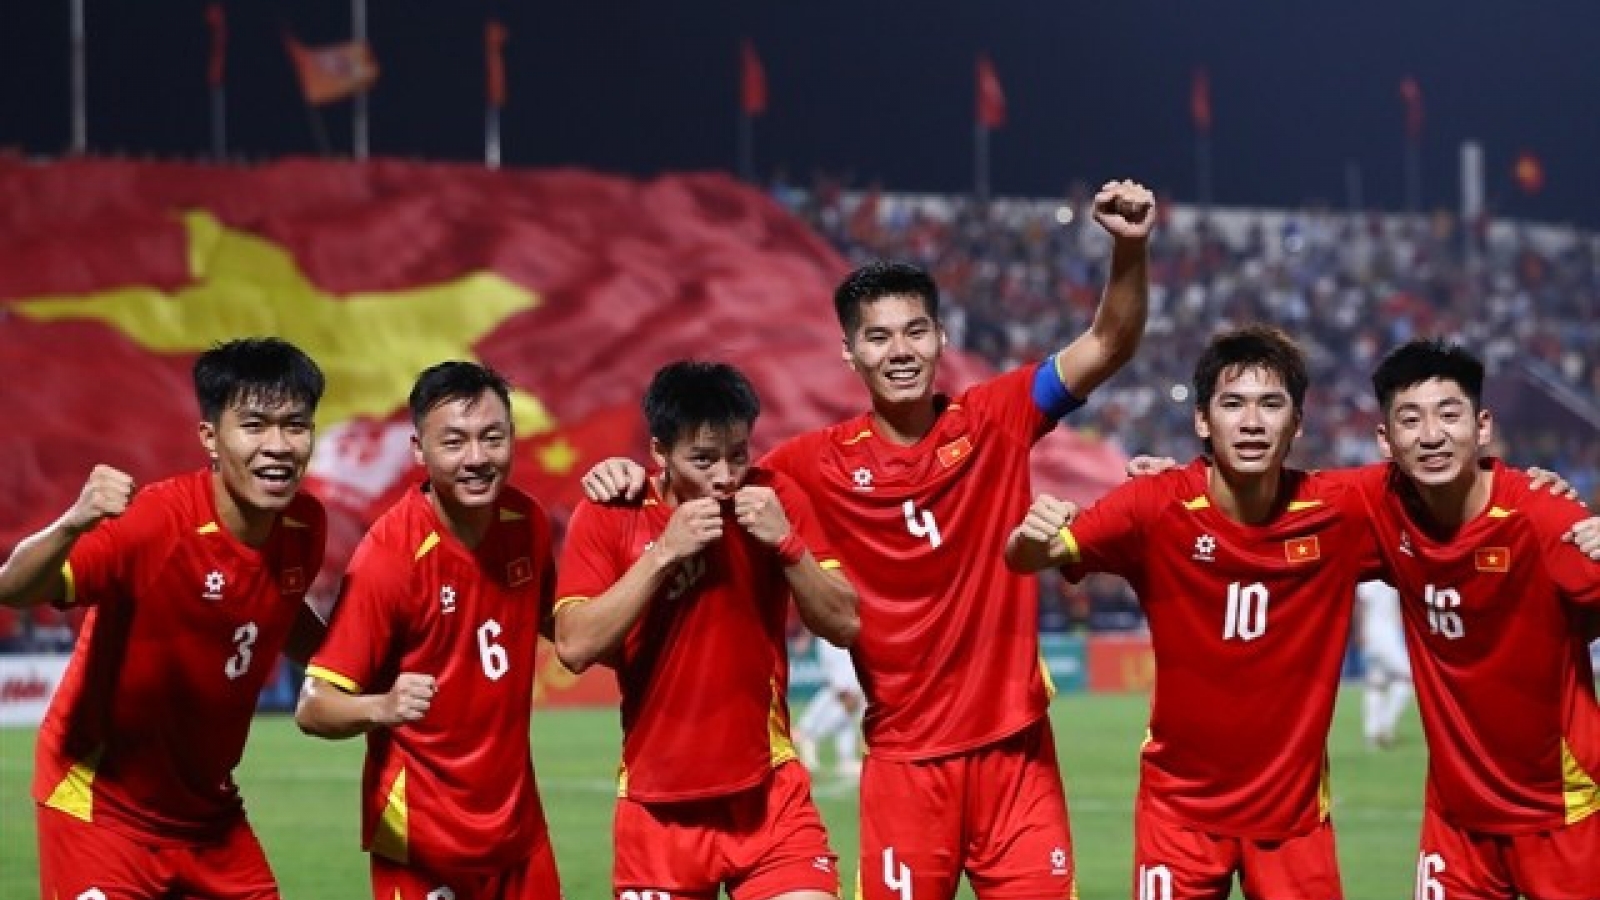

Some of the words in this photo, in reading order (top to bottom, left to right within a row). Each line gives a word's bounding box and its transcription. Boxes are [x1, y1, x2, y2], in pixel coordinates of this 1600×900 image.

[902, 499, 942, 549] 4
[1222, 582, 1269, 641] 10
[1424, 584, 1465, 640] 16
[224, 621, 258, 680] 3
[477, 618, 510, 681] 6
[882, 847, 912, 900] 4
